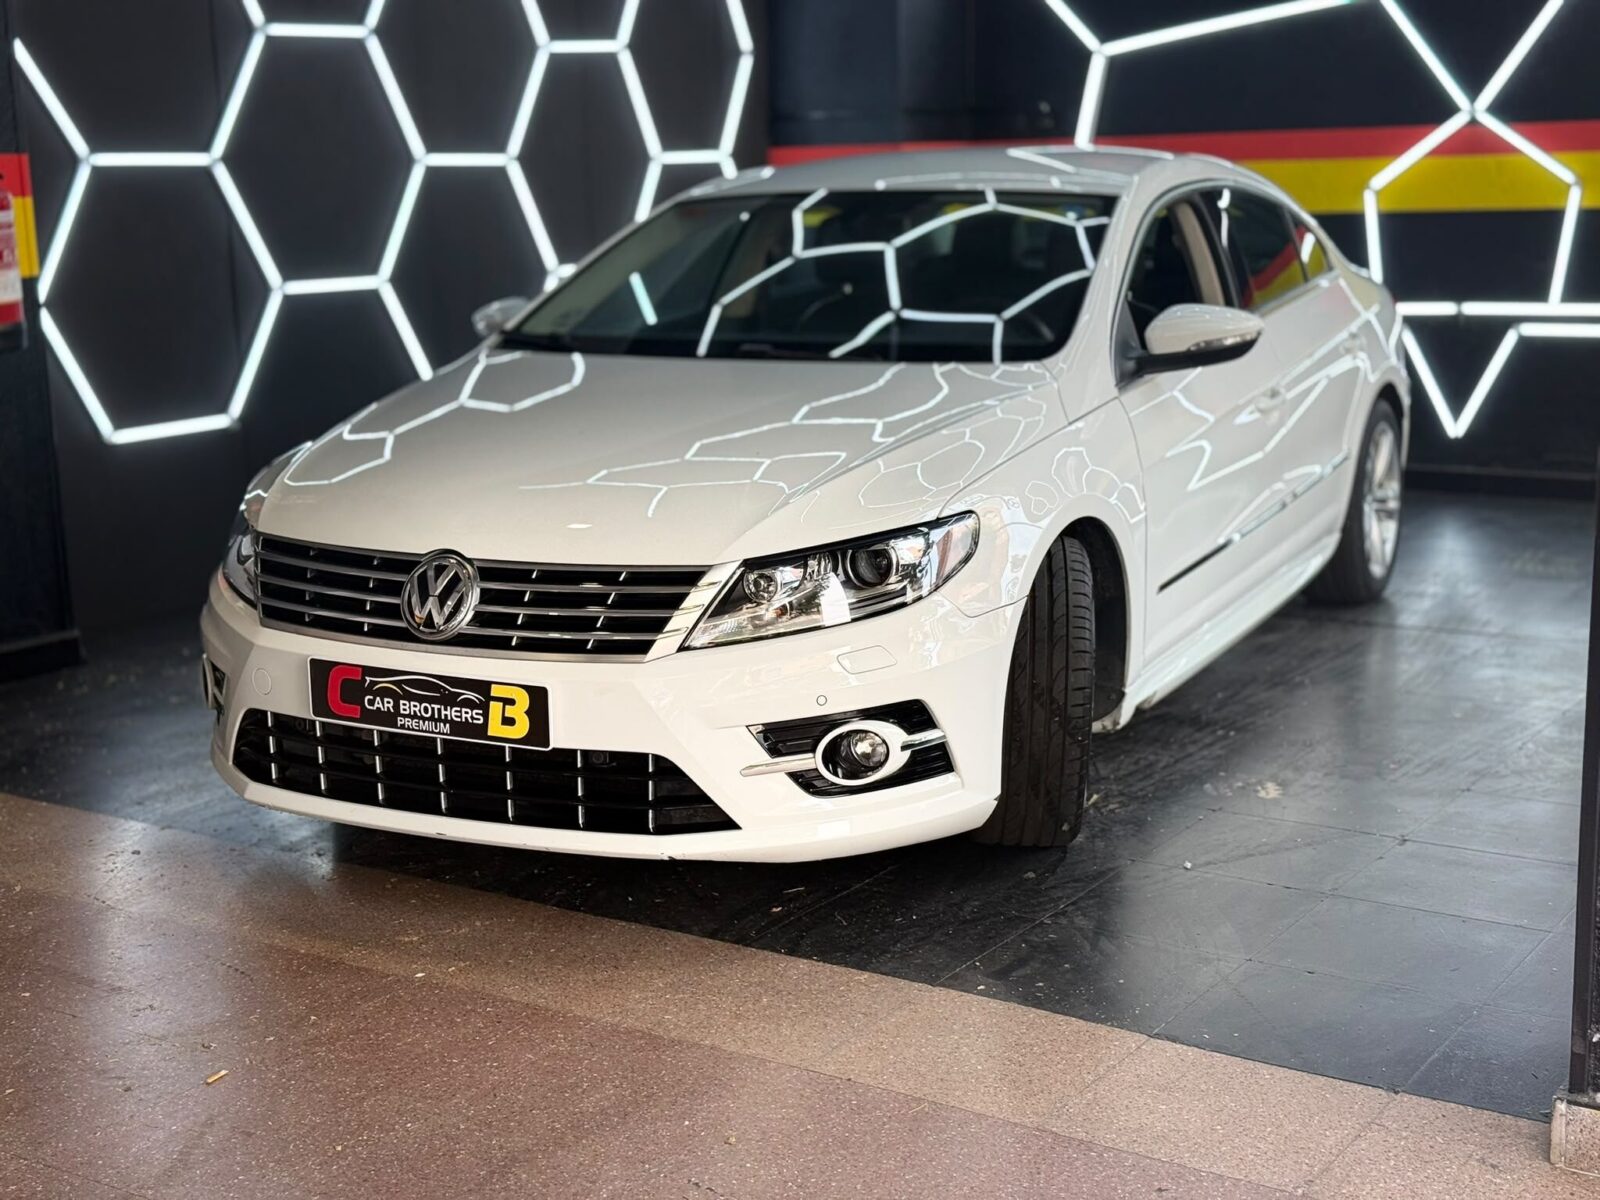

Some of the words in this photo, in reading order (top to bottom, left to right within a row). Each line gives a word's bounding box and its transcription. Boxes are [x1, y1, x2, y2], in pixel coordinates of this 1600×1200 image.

[405, 559, 469, 631] VW
[327, 664, 363, 719] C
[364, 695, 394, 713] CAR
[399, 700, 484, 724] BROTHERS
[487, 683, 530, 740] B
[397, 716, 451, 734] PREMIUM
